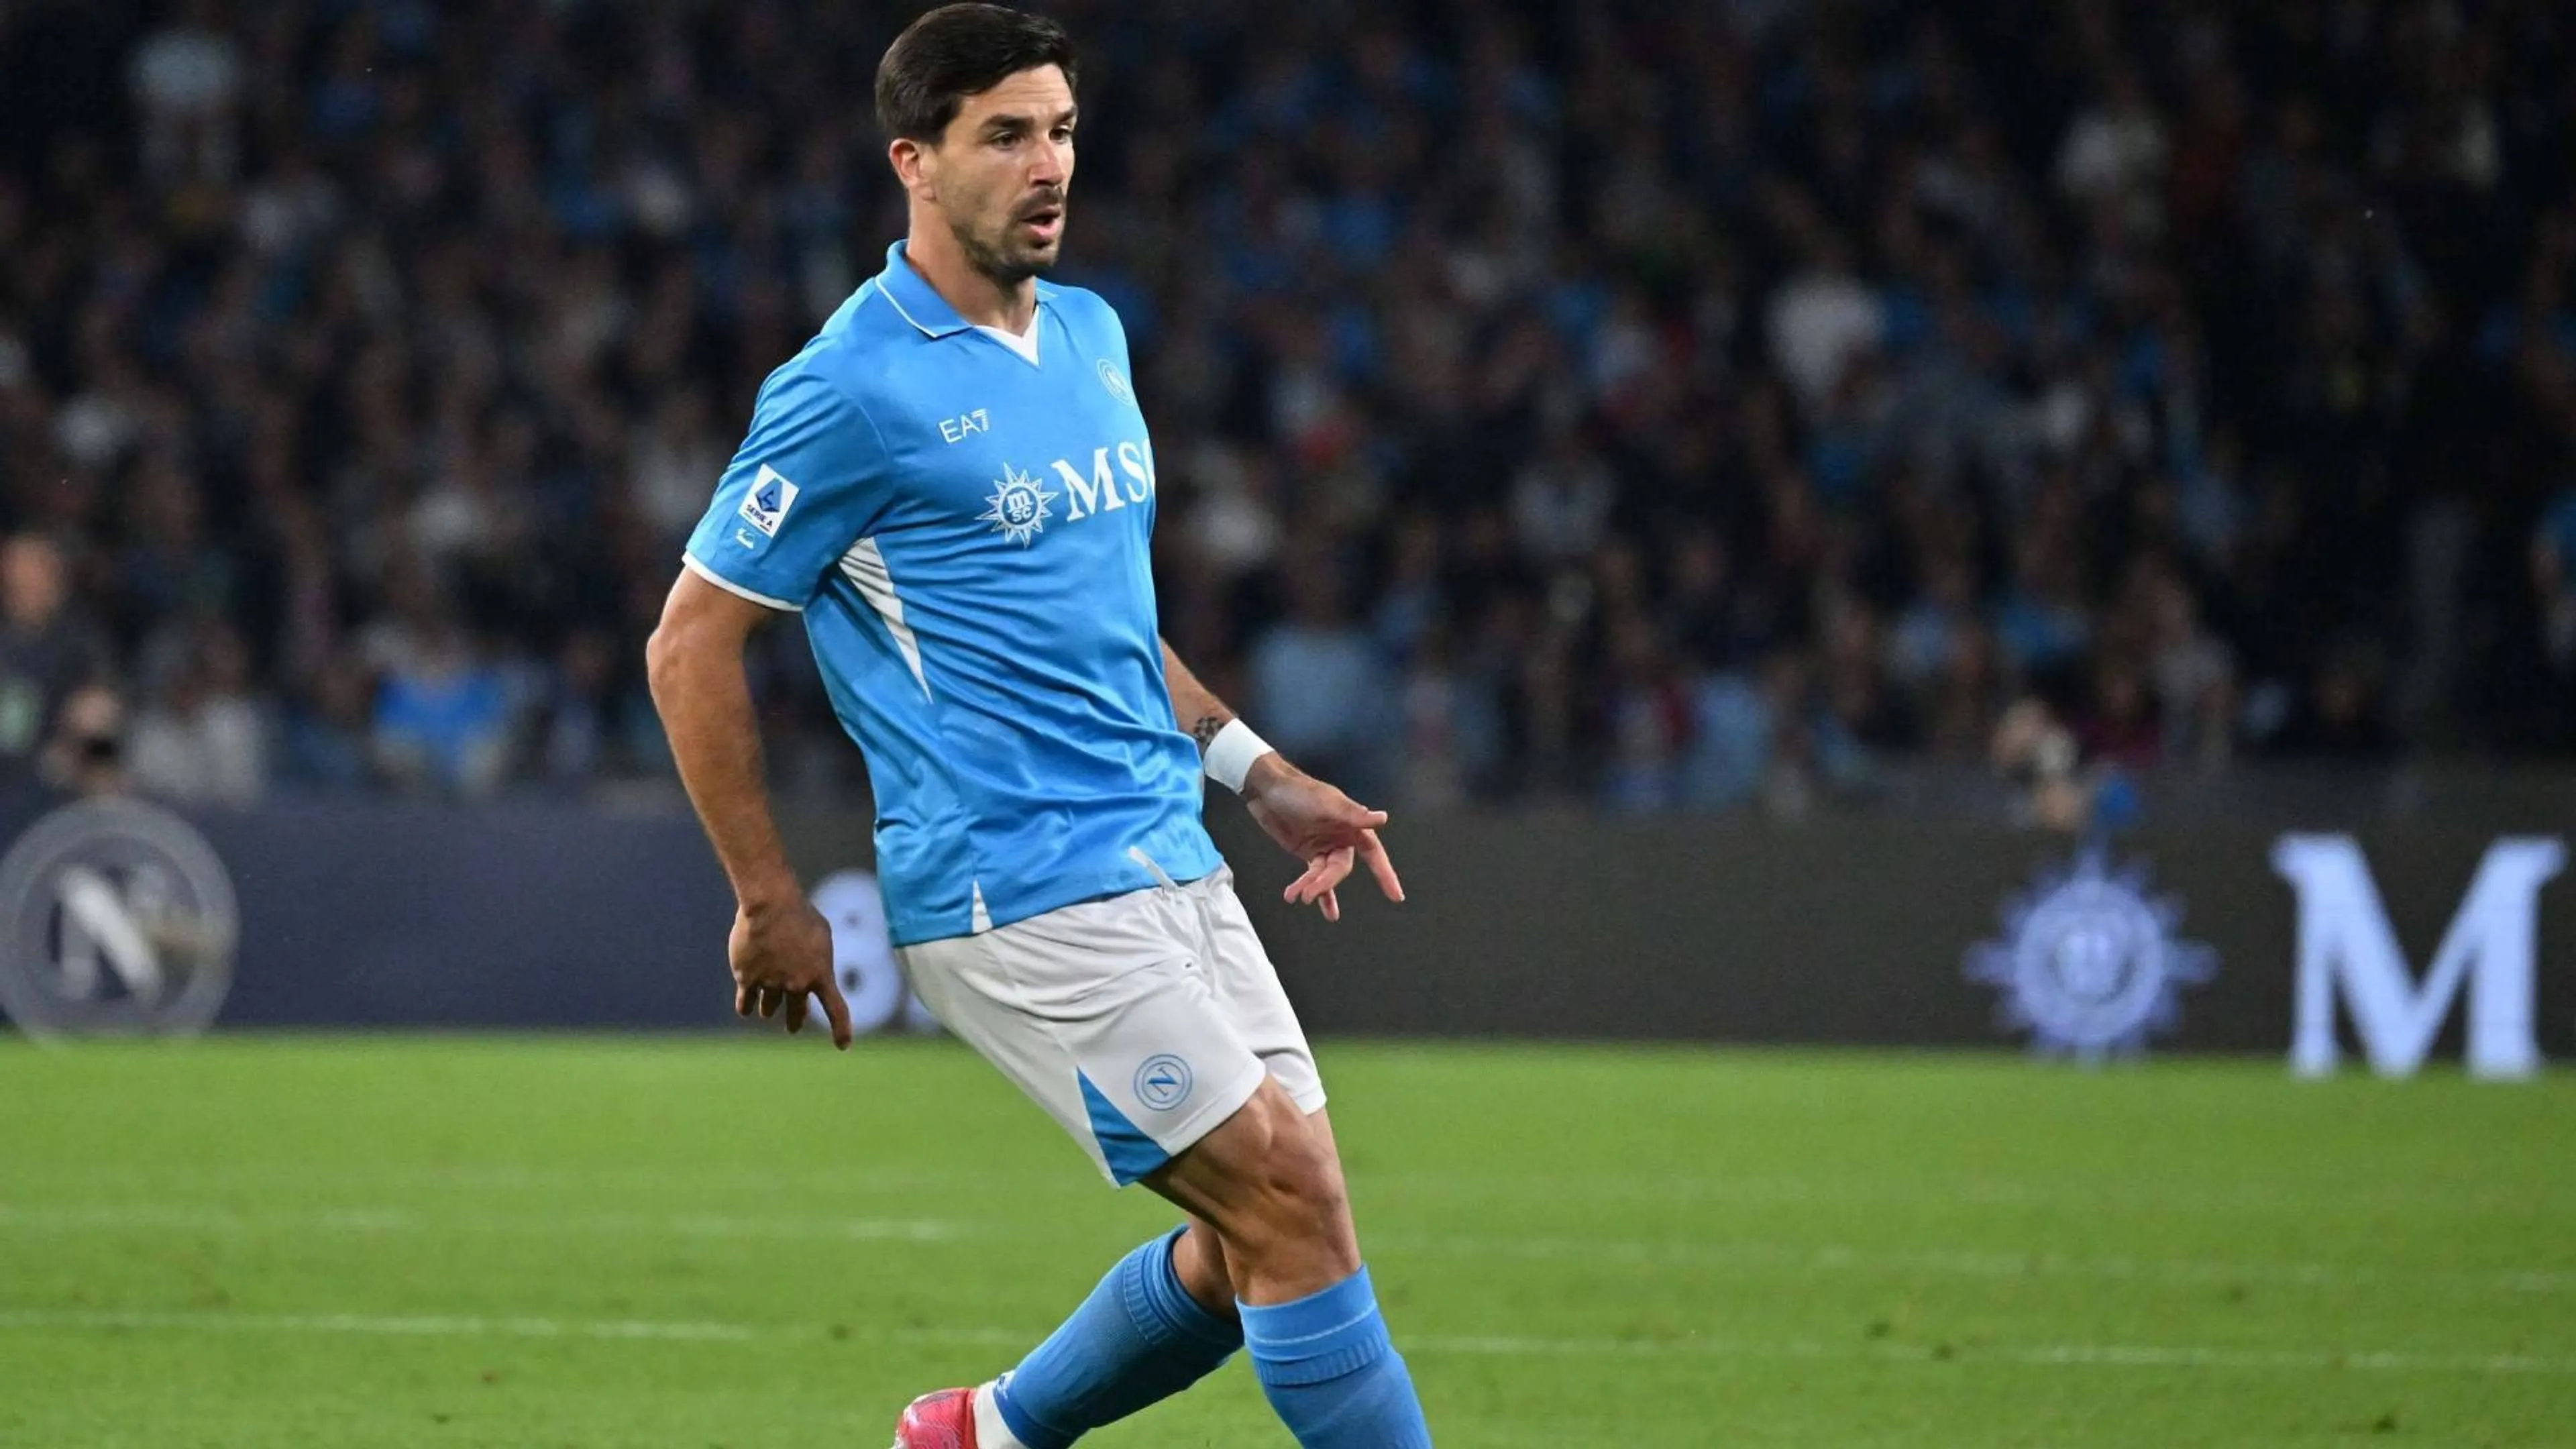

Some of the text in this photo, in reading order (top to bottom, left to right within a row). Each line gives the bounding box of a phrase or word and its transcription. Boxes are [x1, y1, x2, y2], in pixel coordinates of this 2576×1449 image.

[938, 408, 989, 443] EA7
[746, 504, 767, 523] SERIE
[2271, 834, 2568, 1081] M
[1146, 1066, 1179, 1097] N
